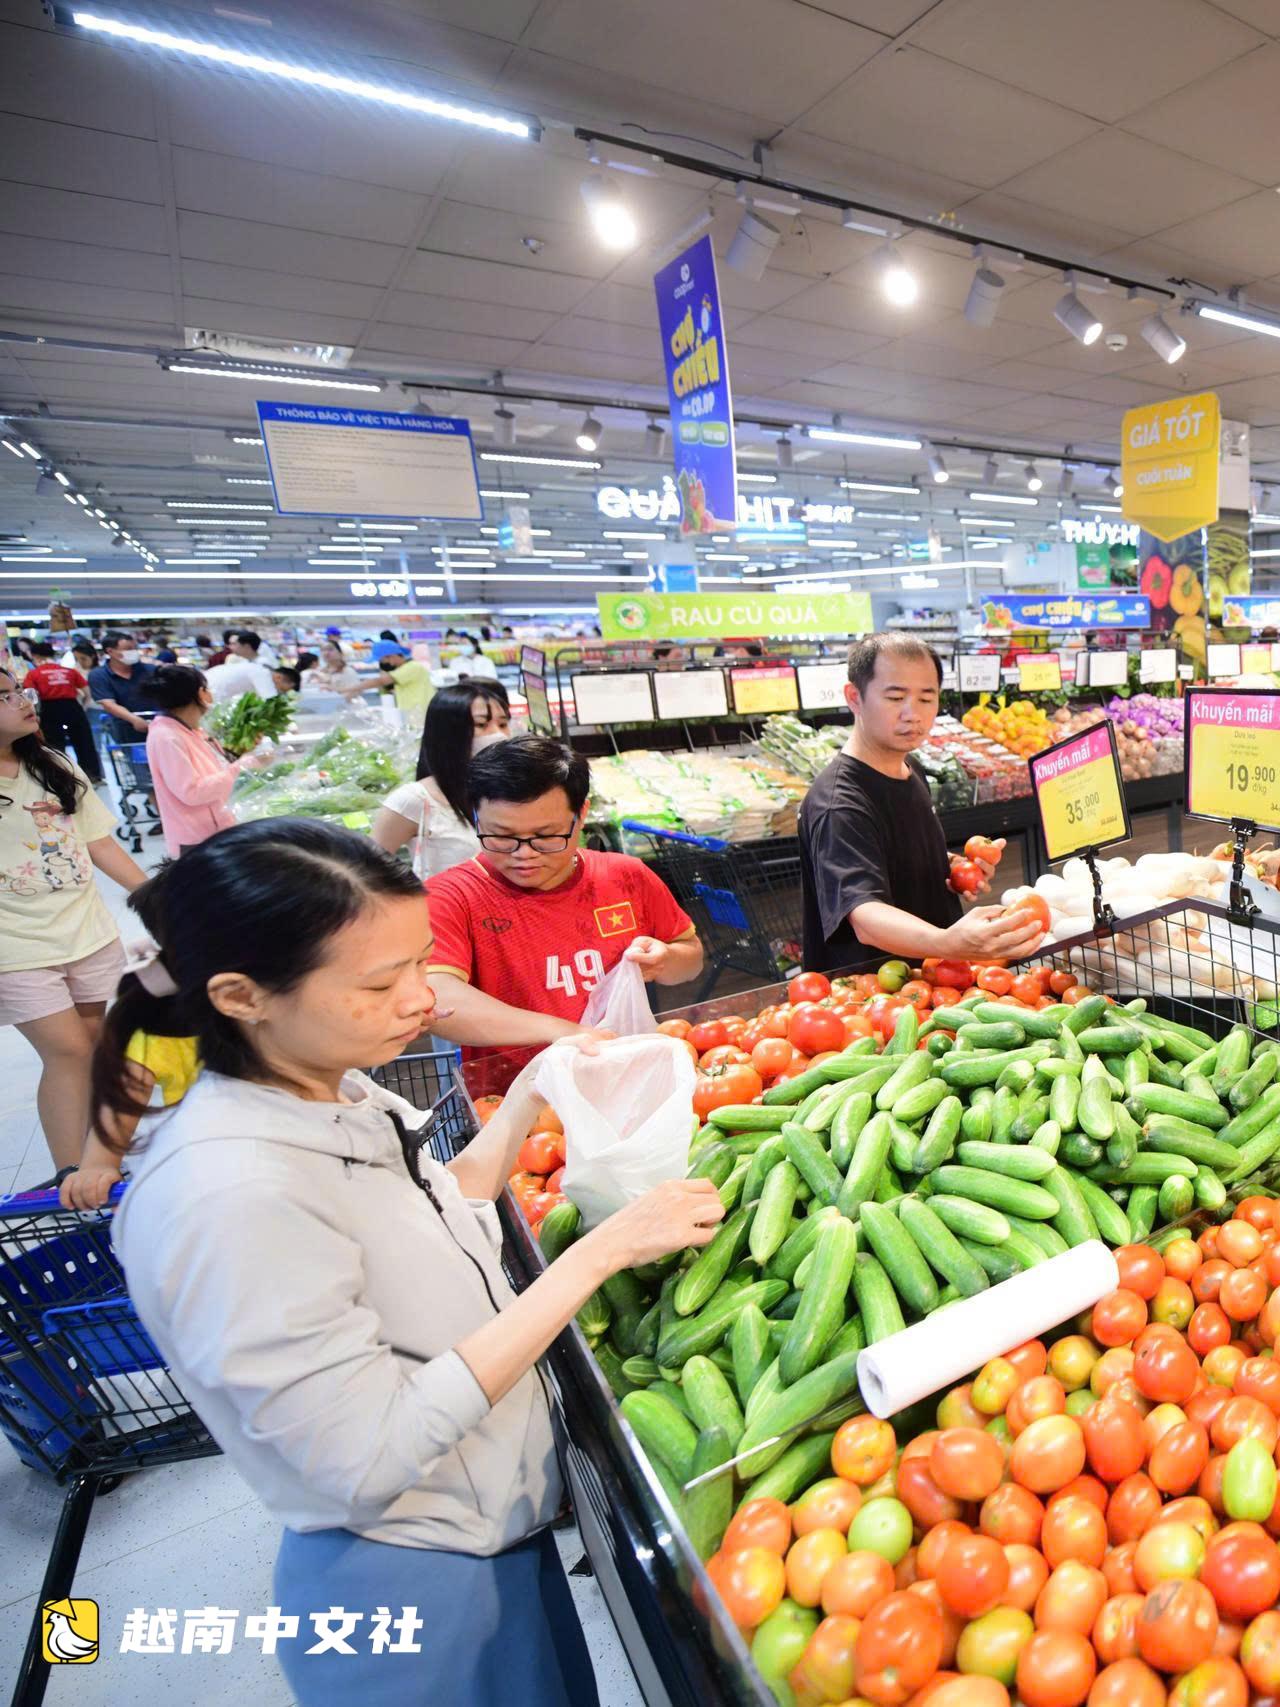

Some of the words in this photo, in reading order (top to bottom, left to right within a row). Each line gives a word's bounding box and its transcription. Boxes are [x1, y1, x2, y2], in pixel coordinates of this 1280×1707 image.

[671, 607, 723, 626] RAU
[728, 601, 763, 625] CỦ
[1192, 700, 1243, 724] Khuyến
[1246, 702, 1274, 723] mãi
[1035, 752, 1070, 780] Khuyến
[1072, 741, 1091, 765] mãi
[546, 949, 605, 998] 49
